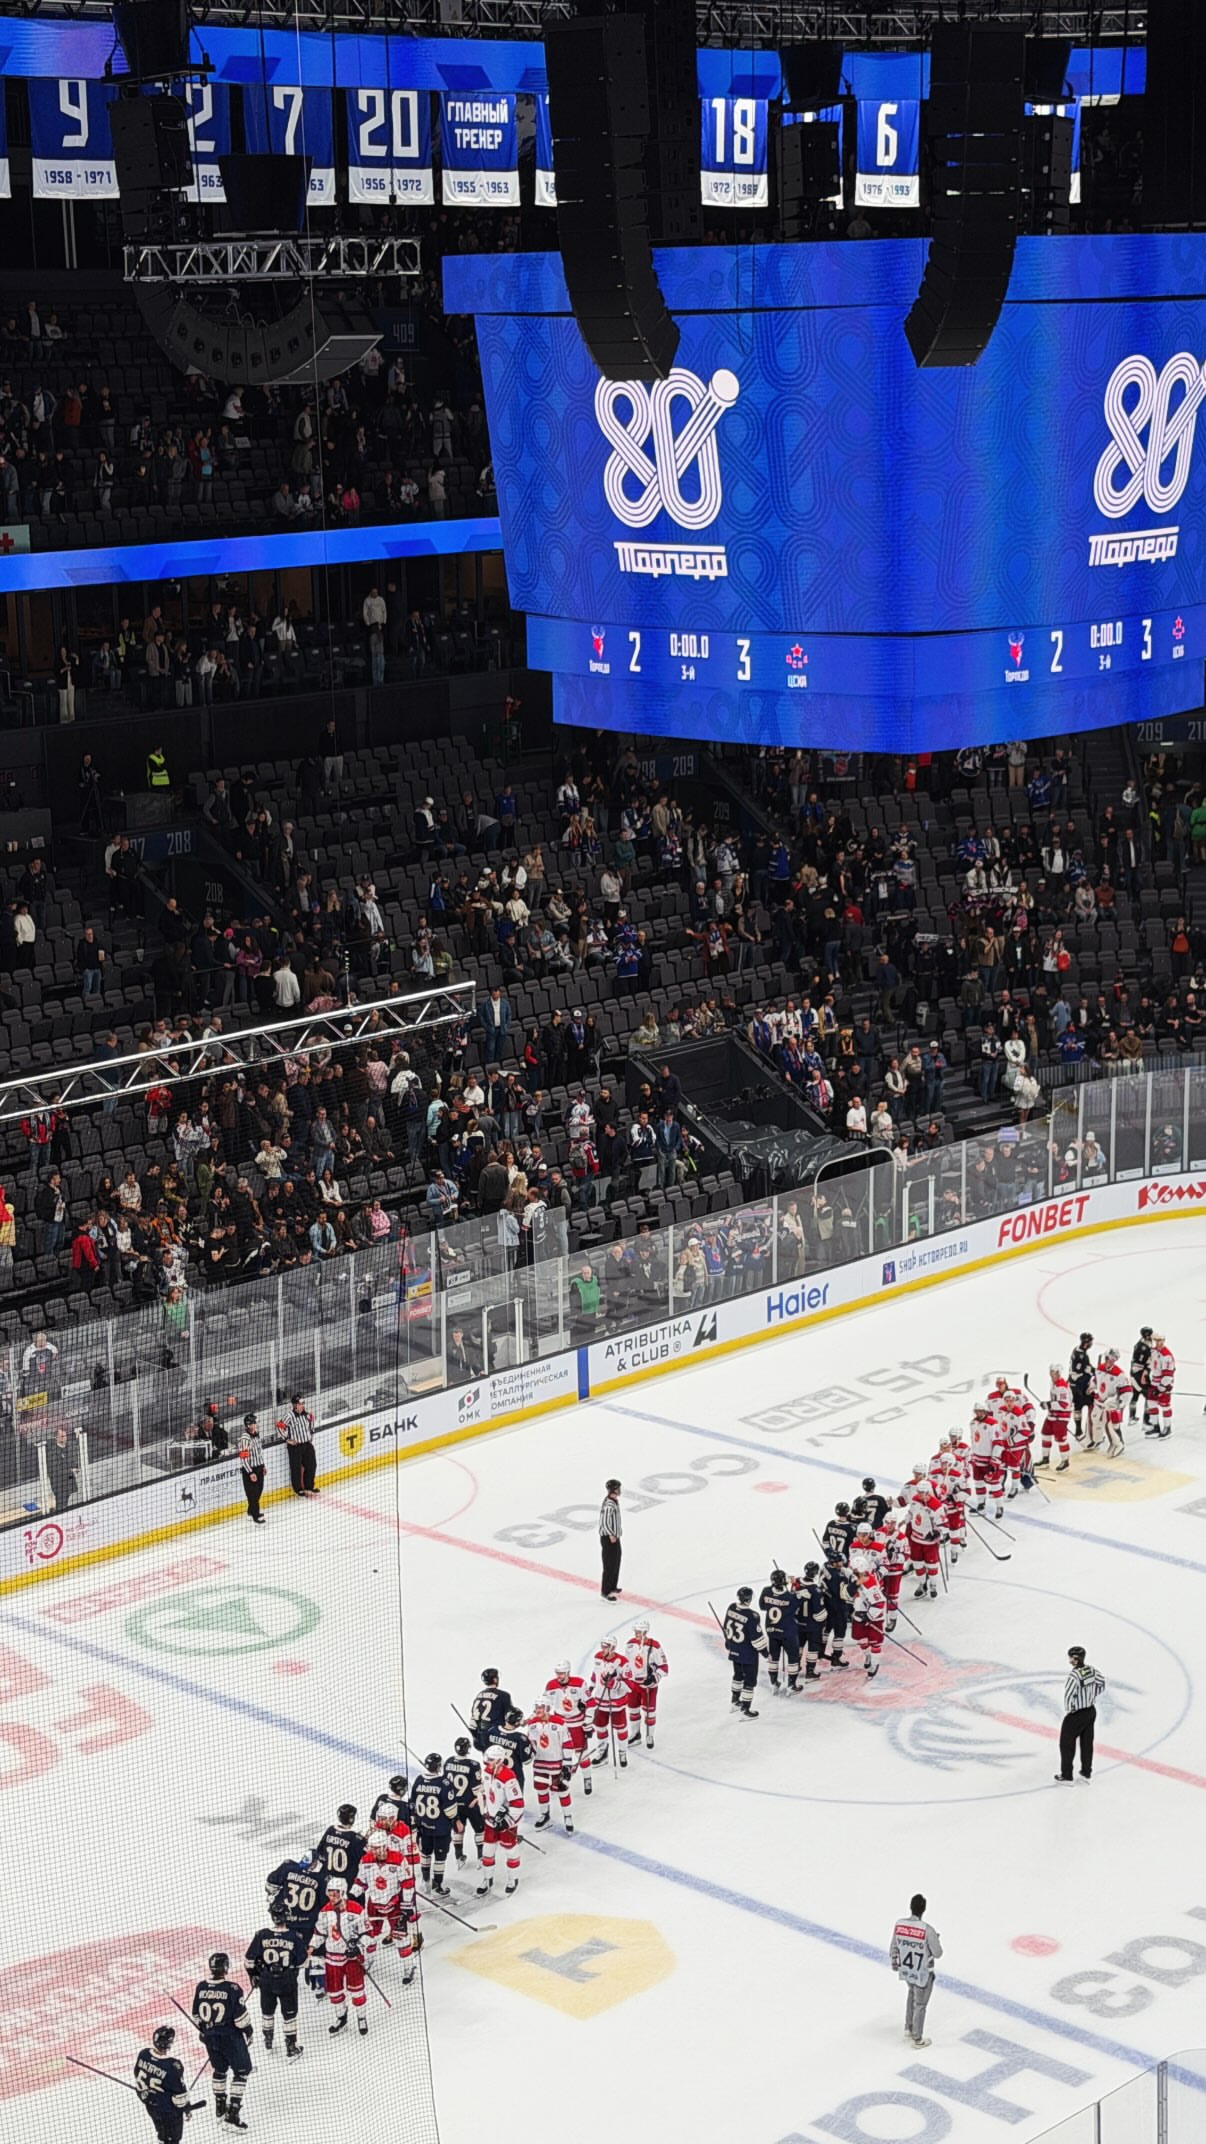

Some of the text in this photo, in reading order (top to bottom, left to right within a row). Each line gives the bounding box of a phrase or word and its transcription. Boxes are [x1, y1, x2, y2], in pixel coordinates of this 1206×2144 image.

[59, 80, 88, 147] 9
[273, 87, 303, 155] 7
[358, 90, 419, 157] 20
[447, 99, 508, 124] ГЛАВНЫЙ
[454, 128, 503, 149] ТРЕНЕР
[712, 98, 756, 165] 18
[876, 103, 898, 166] 6
[44, 170, 73, 184] 1958
[84, 170, 112, 184] 1971
[361, 177, 386, 190] 1956
[396, 178, 422, 191] 1972
[453, 180, 476, 193] 1955
[486, 180, 510, 193] 1963
[710, 182, 730, 193] 1972
[670, 633, 709, 658] 0:00.0
[1090, 621, 1123, 648] 0:00.0
[1142, 619, 1152, 660] 3
[629, 632, 641, 672] 2
[737, 639, 750, 680] 3
[1051, 631, 1063, 673] 2
[1137, 722, 1163, 742] 209
[672, 755, 694, 777] 209
[166, 830, 191, 856] 208
[204, 882, 223, 903] 208
[997, 1194, 1090, 1248] FONBET
[767, 1282, 829, 1323] Haier
[605, 1319, 692, 1359] ATRIBUTIKA
[617, 1358, 627, 1372] &
[632, 1342, 669, 1367] CLUB
[369, 1414, 419, 1443] БАНК
[769, 1606, 782, 1624] 9
[724, 1619, 745, 1643] 63
[416, 1794, 441, 1820] 68
[325, 1846, 348, 1873] 10
[284, 1882, 316, 1912] 30
[902, 1951, 924, 1972] 47
